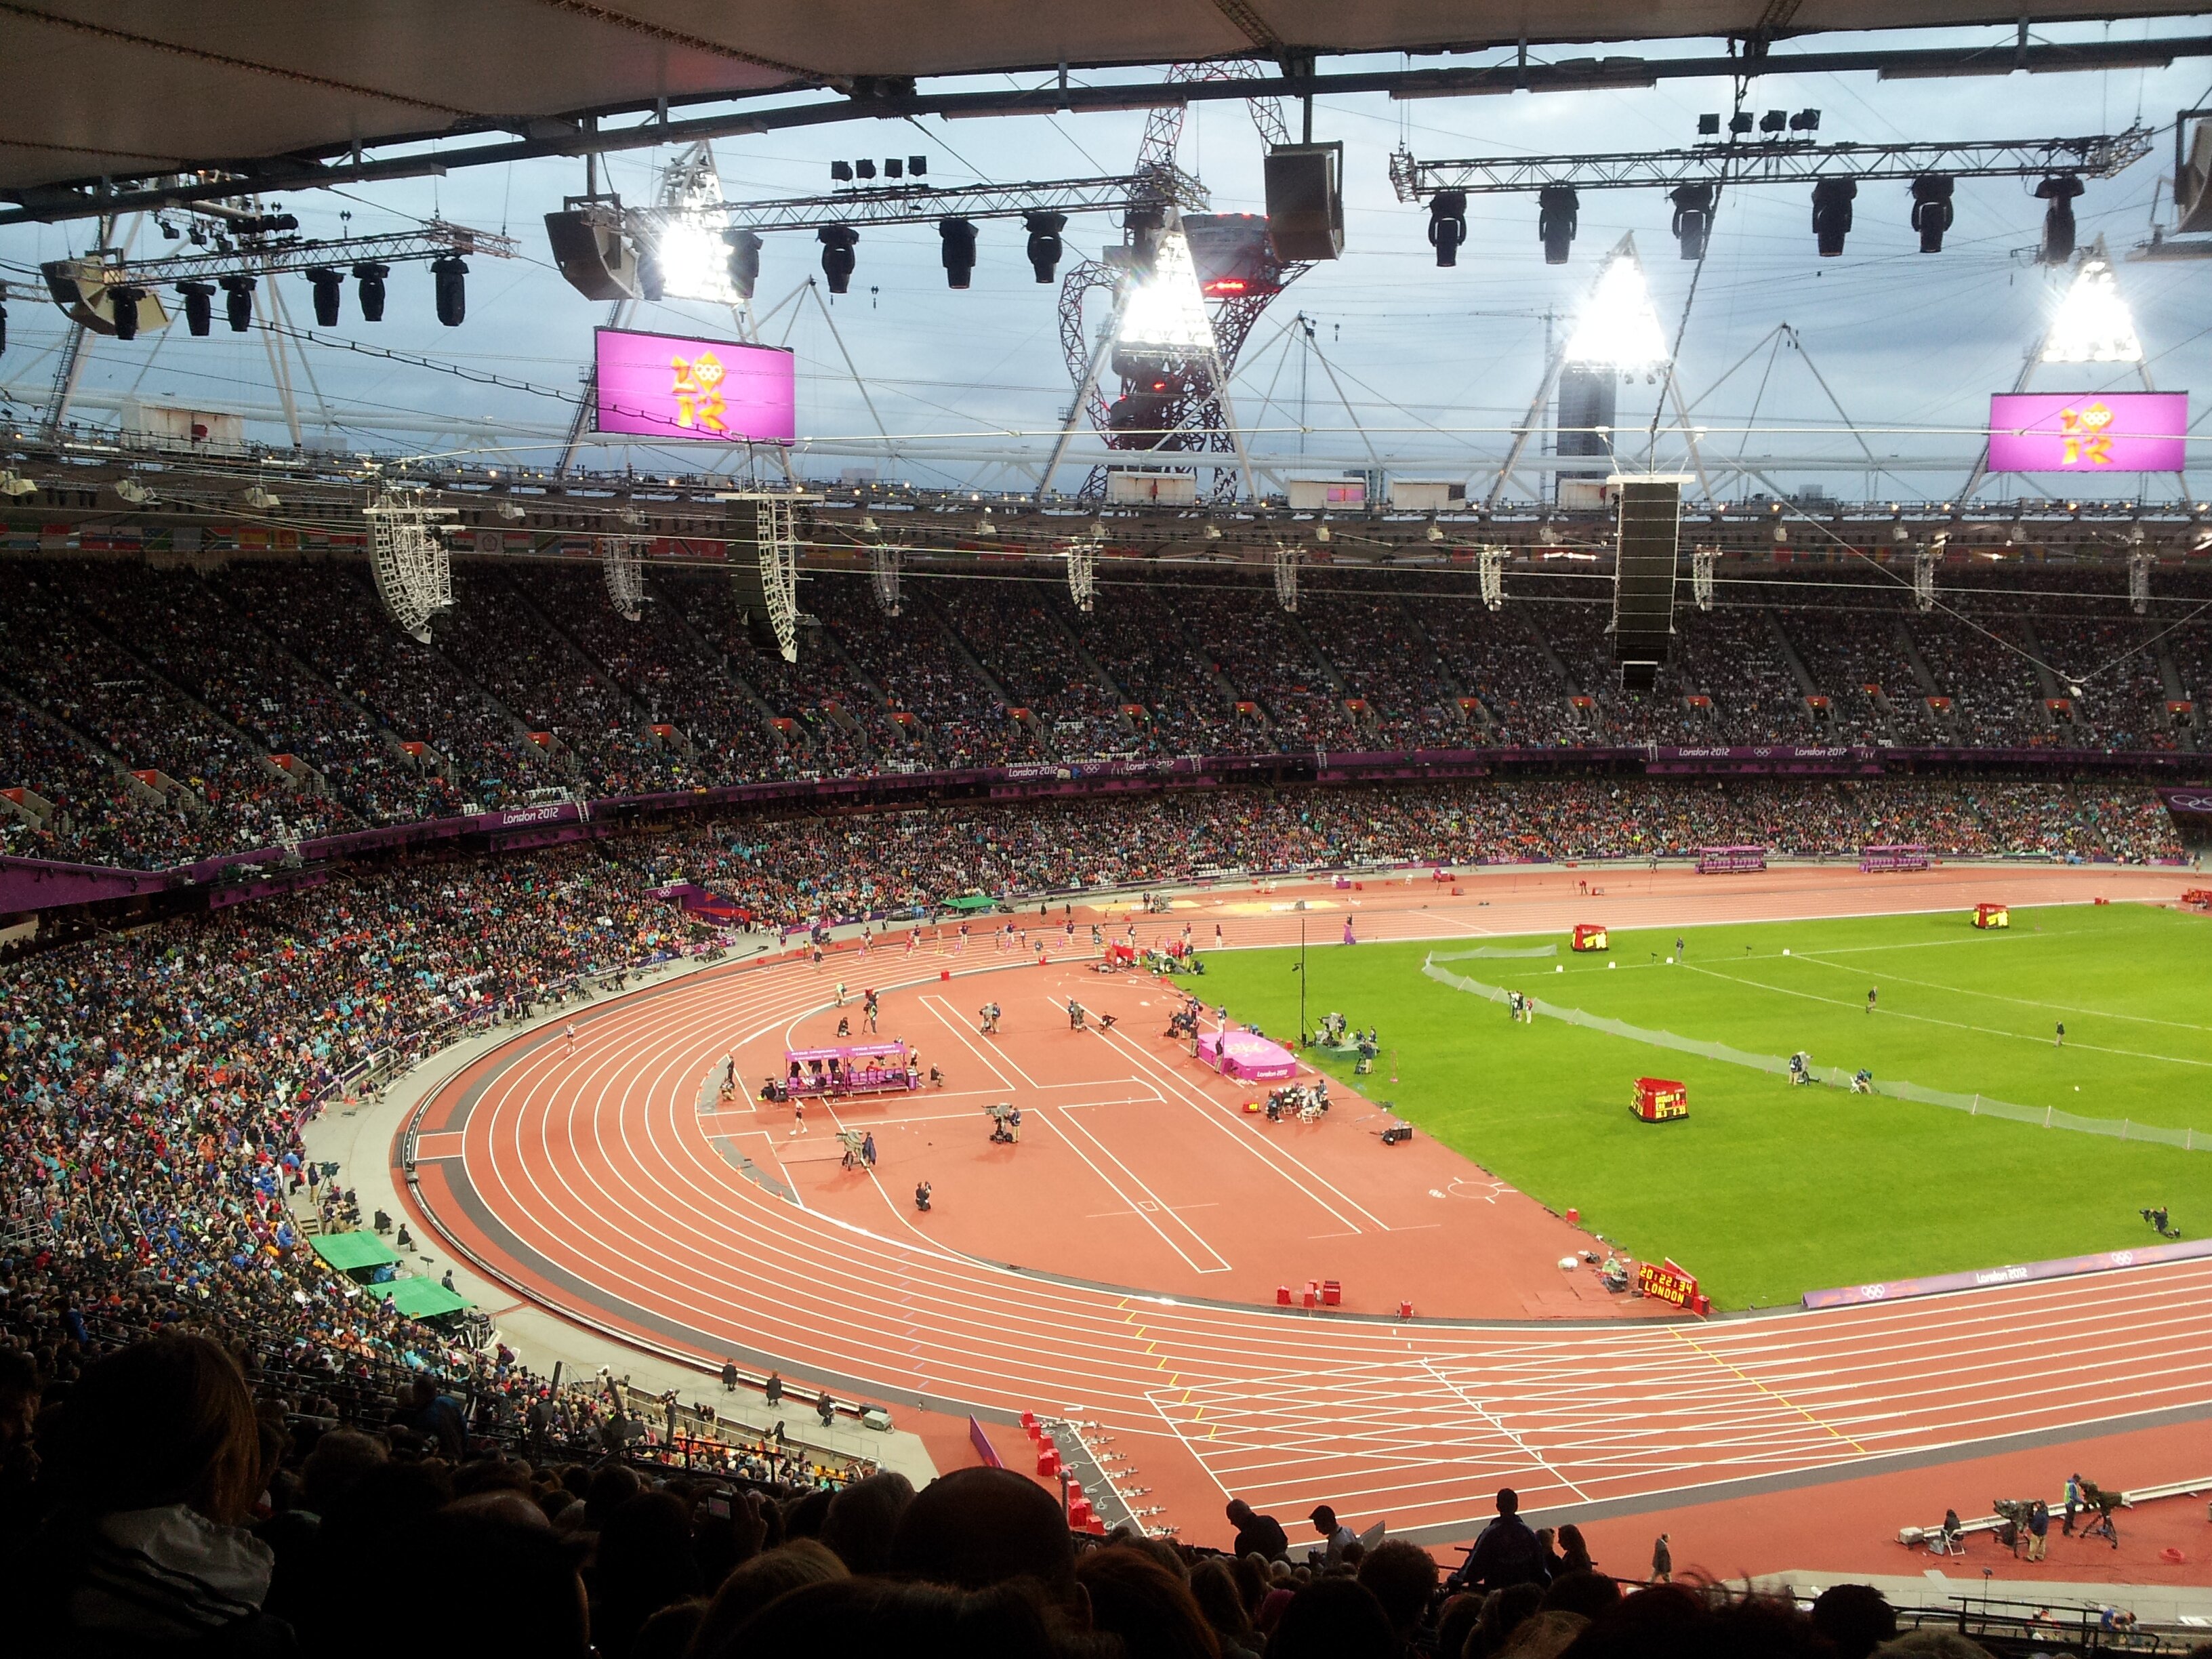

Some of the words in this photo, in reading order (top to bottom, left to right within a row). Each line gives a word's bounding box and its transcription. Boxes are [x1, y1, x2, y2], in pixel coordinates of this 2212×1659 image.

[1679, 747, 1708, 756] London
[1710, 747, 1730, 756] 2012
[1795, 747, 1826, 756] London
[1827, 747, 1847, 756] 2012
[1008, 767, 1038, 777] London
[1039, 766, 1058, 775] 2012
[503, 811, 535, 825] London
[537, 807, 558, 819] 2012
[1640, 1267, 1692, 1294] 20:22:34
[1975, 1270, 2008, 1284] London
[2007, 1267, 2028, 1279] 2012
[1644, 1280, 1685, 1304] LONDON
